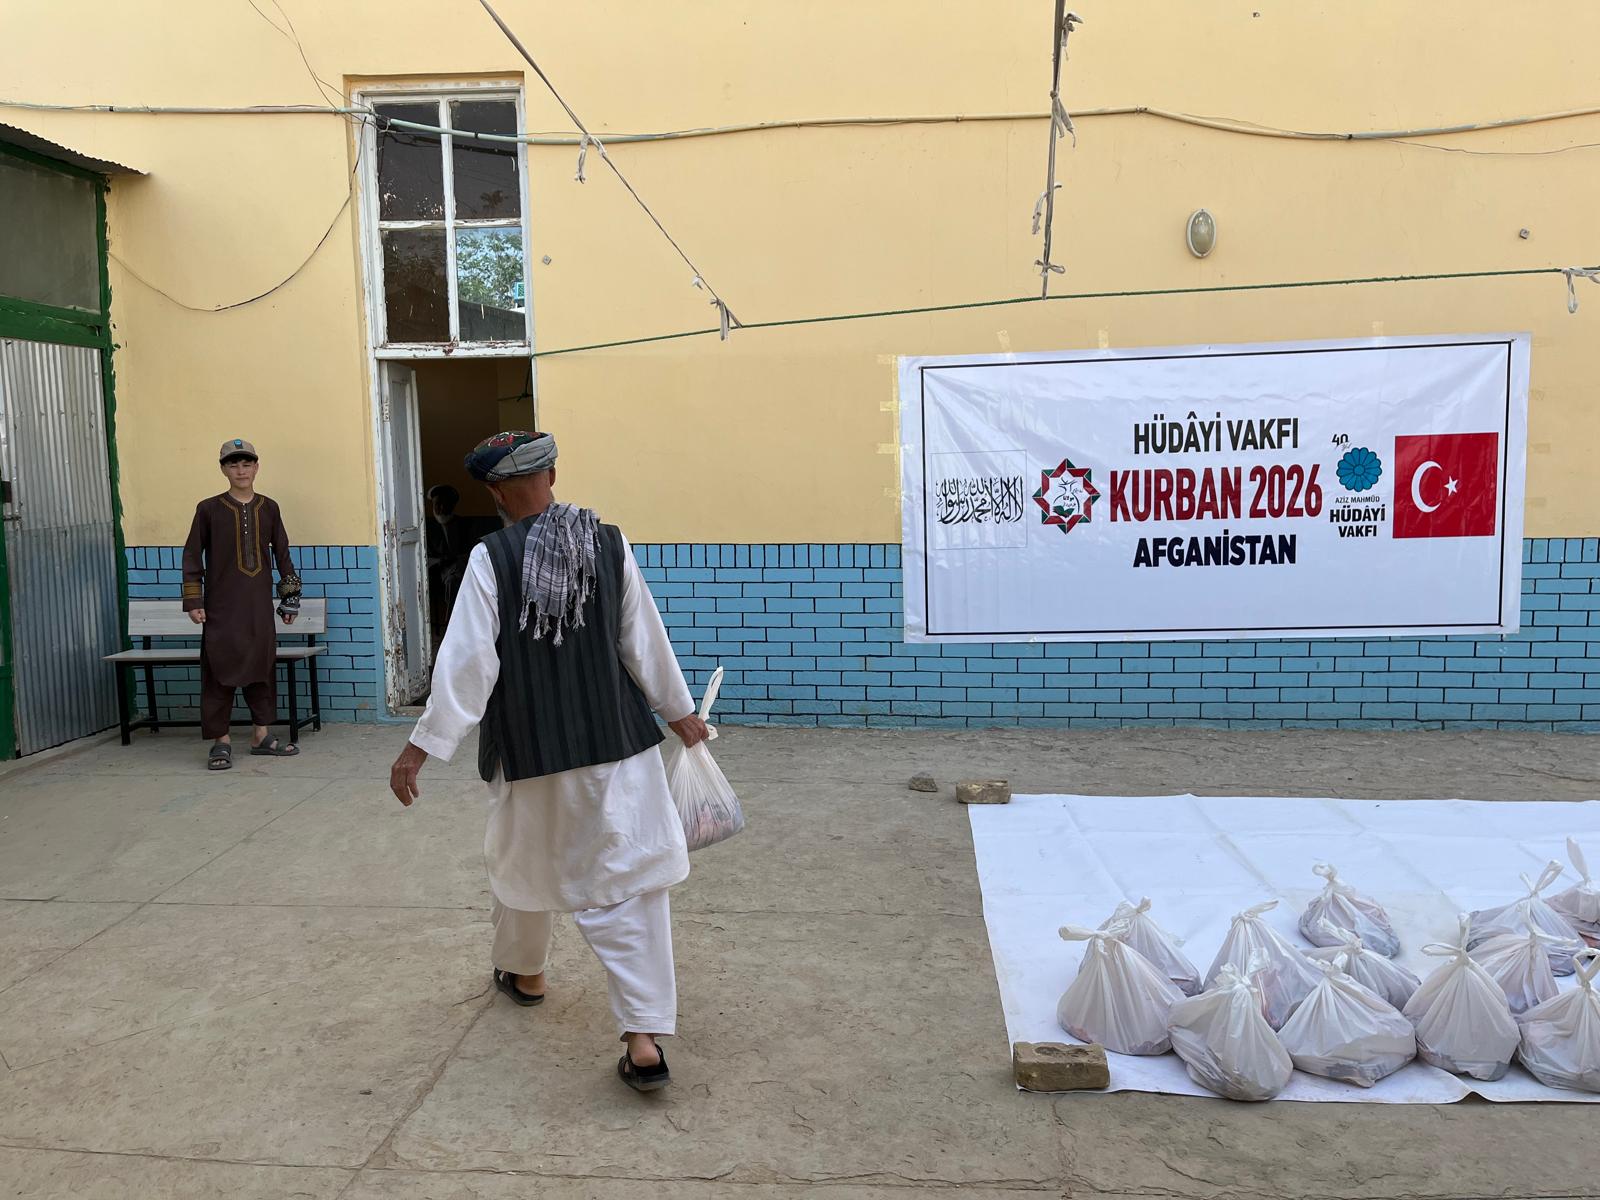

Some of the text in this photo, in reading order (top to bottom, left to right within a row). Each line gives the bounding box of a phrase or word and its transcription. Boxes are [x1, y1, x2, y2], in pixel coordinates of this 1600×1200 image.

[1134, 411, 1299, 454] HÜDÂYİ VAKFI
[1110, 464, 1323, 522] KURBAN 2026
[1335, 496, 1349, 504] AZİZ
[1329, 504, 1386, 523] HÜDÂYİ
[1338, 525, 1377, 538] VAKFI
[1133, 529, 1297, 567] AFGANİSTAN
